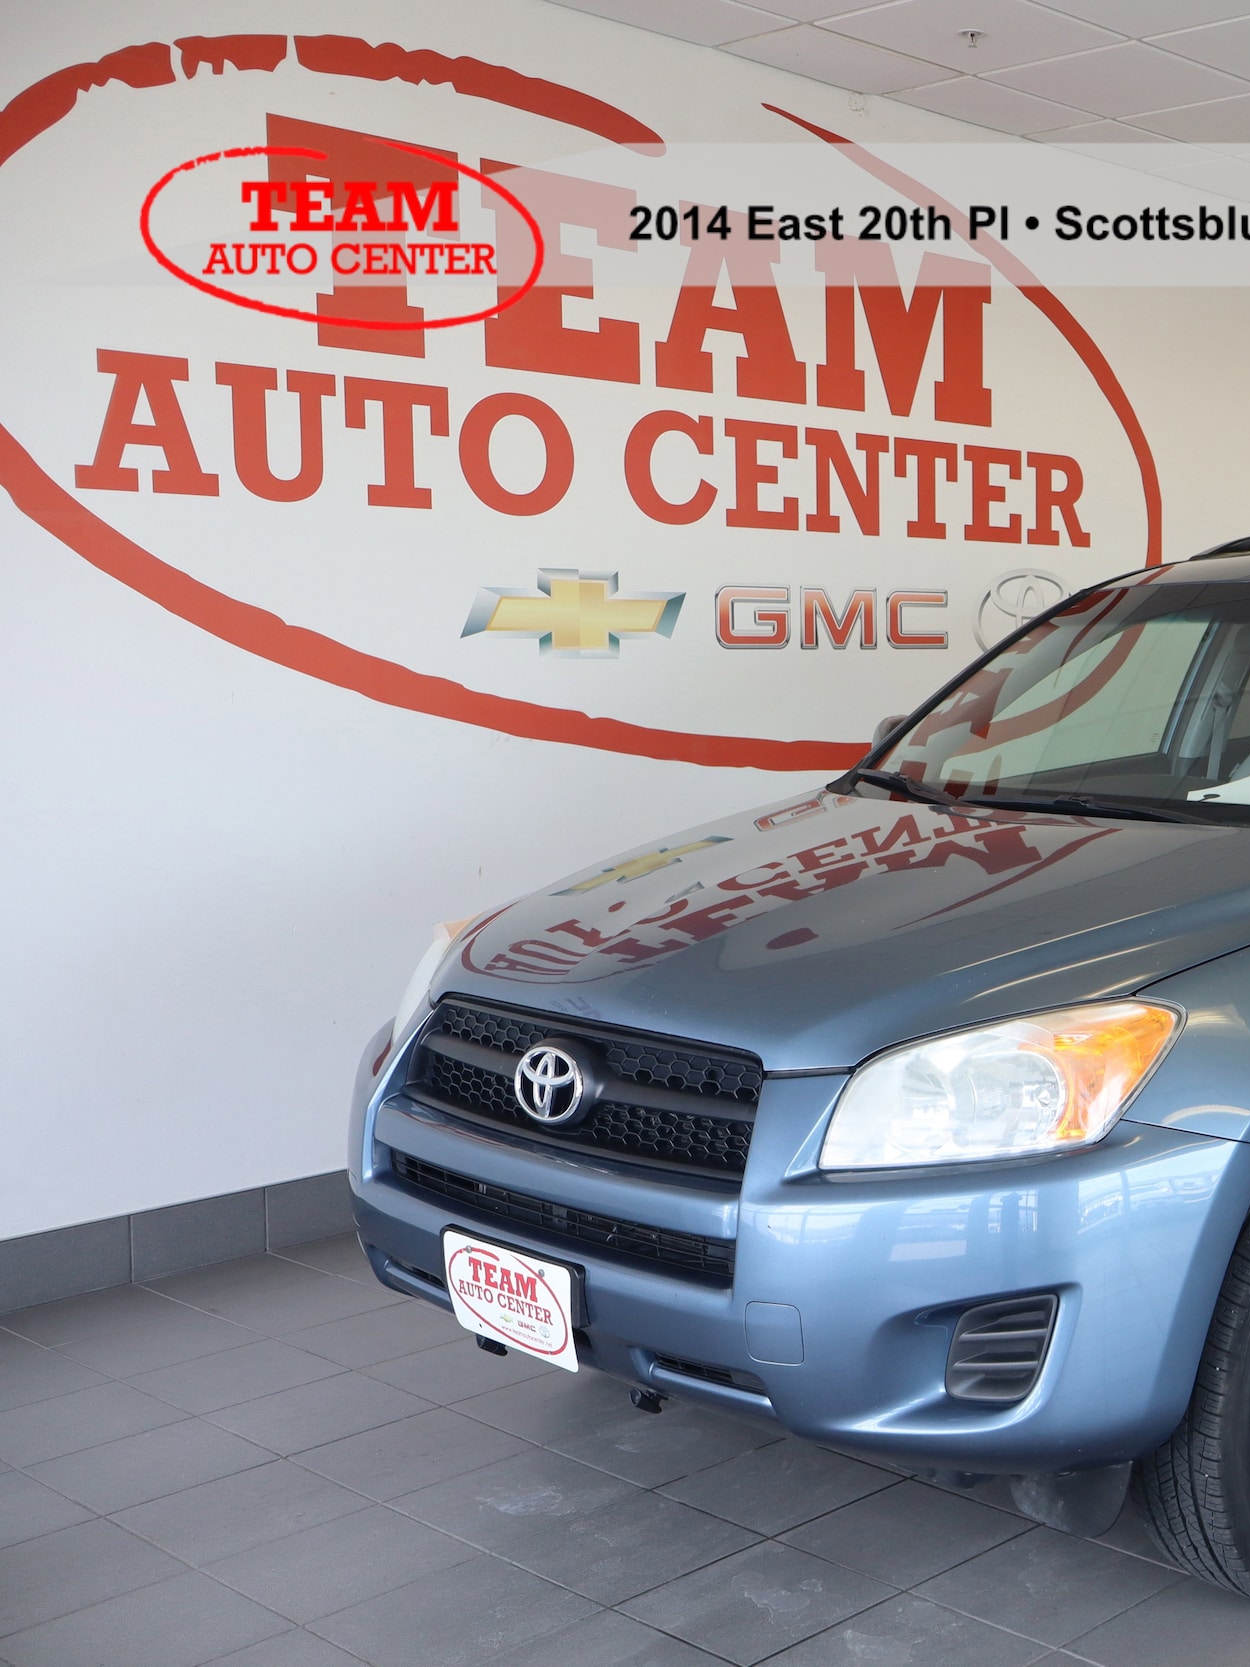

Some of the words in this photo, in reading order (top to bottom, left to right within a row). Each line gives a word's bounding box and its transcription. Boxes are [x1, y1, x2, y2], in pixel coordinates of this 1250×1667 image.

[266, 113, 992, 427] TEAM
[75, 348, 574, 516] AUTO
[624, 410, 1091, 548] CENTER
[714, 584, 949, 650] GMC
[458, 1279, 494, 1304] AUTO
[497, 1293, 553, 1326] CENTER
[468, 1256, 538, 1303] TEAM
[517, 1320, 537, 1333] GMC
